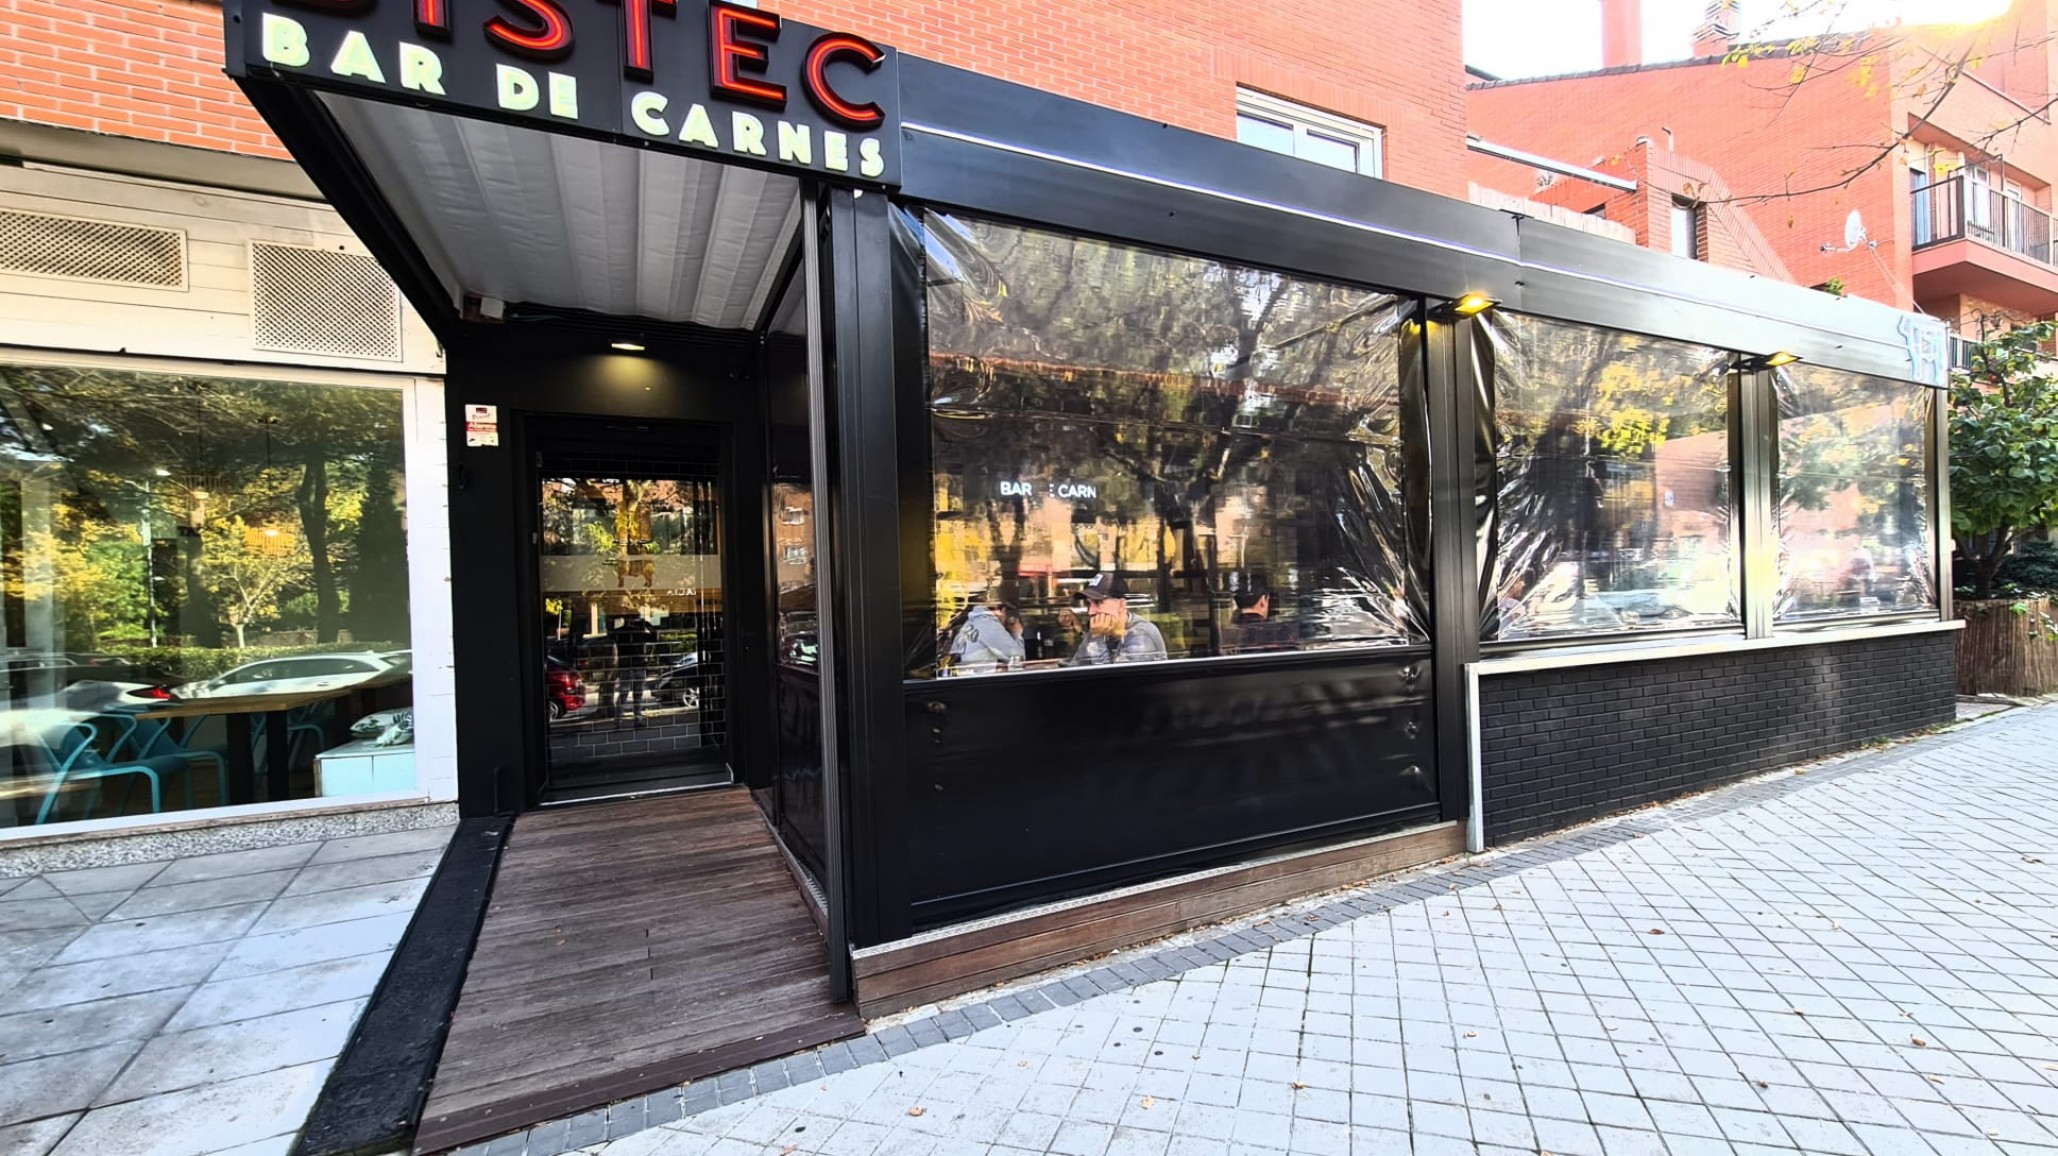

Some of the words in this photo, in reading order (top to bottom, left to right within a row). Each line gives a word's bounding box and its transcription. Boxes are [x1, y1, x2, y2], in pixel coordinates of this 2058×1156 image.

[262, 12, 446, 95] BAR
[496, 63, 579, 120] DE
[631, 91, 885, 178] CARNES
[271, 0, 886, 129] STEC
[1000, 481, 1032, 496] BAR
